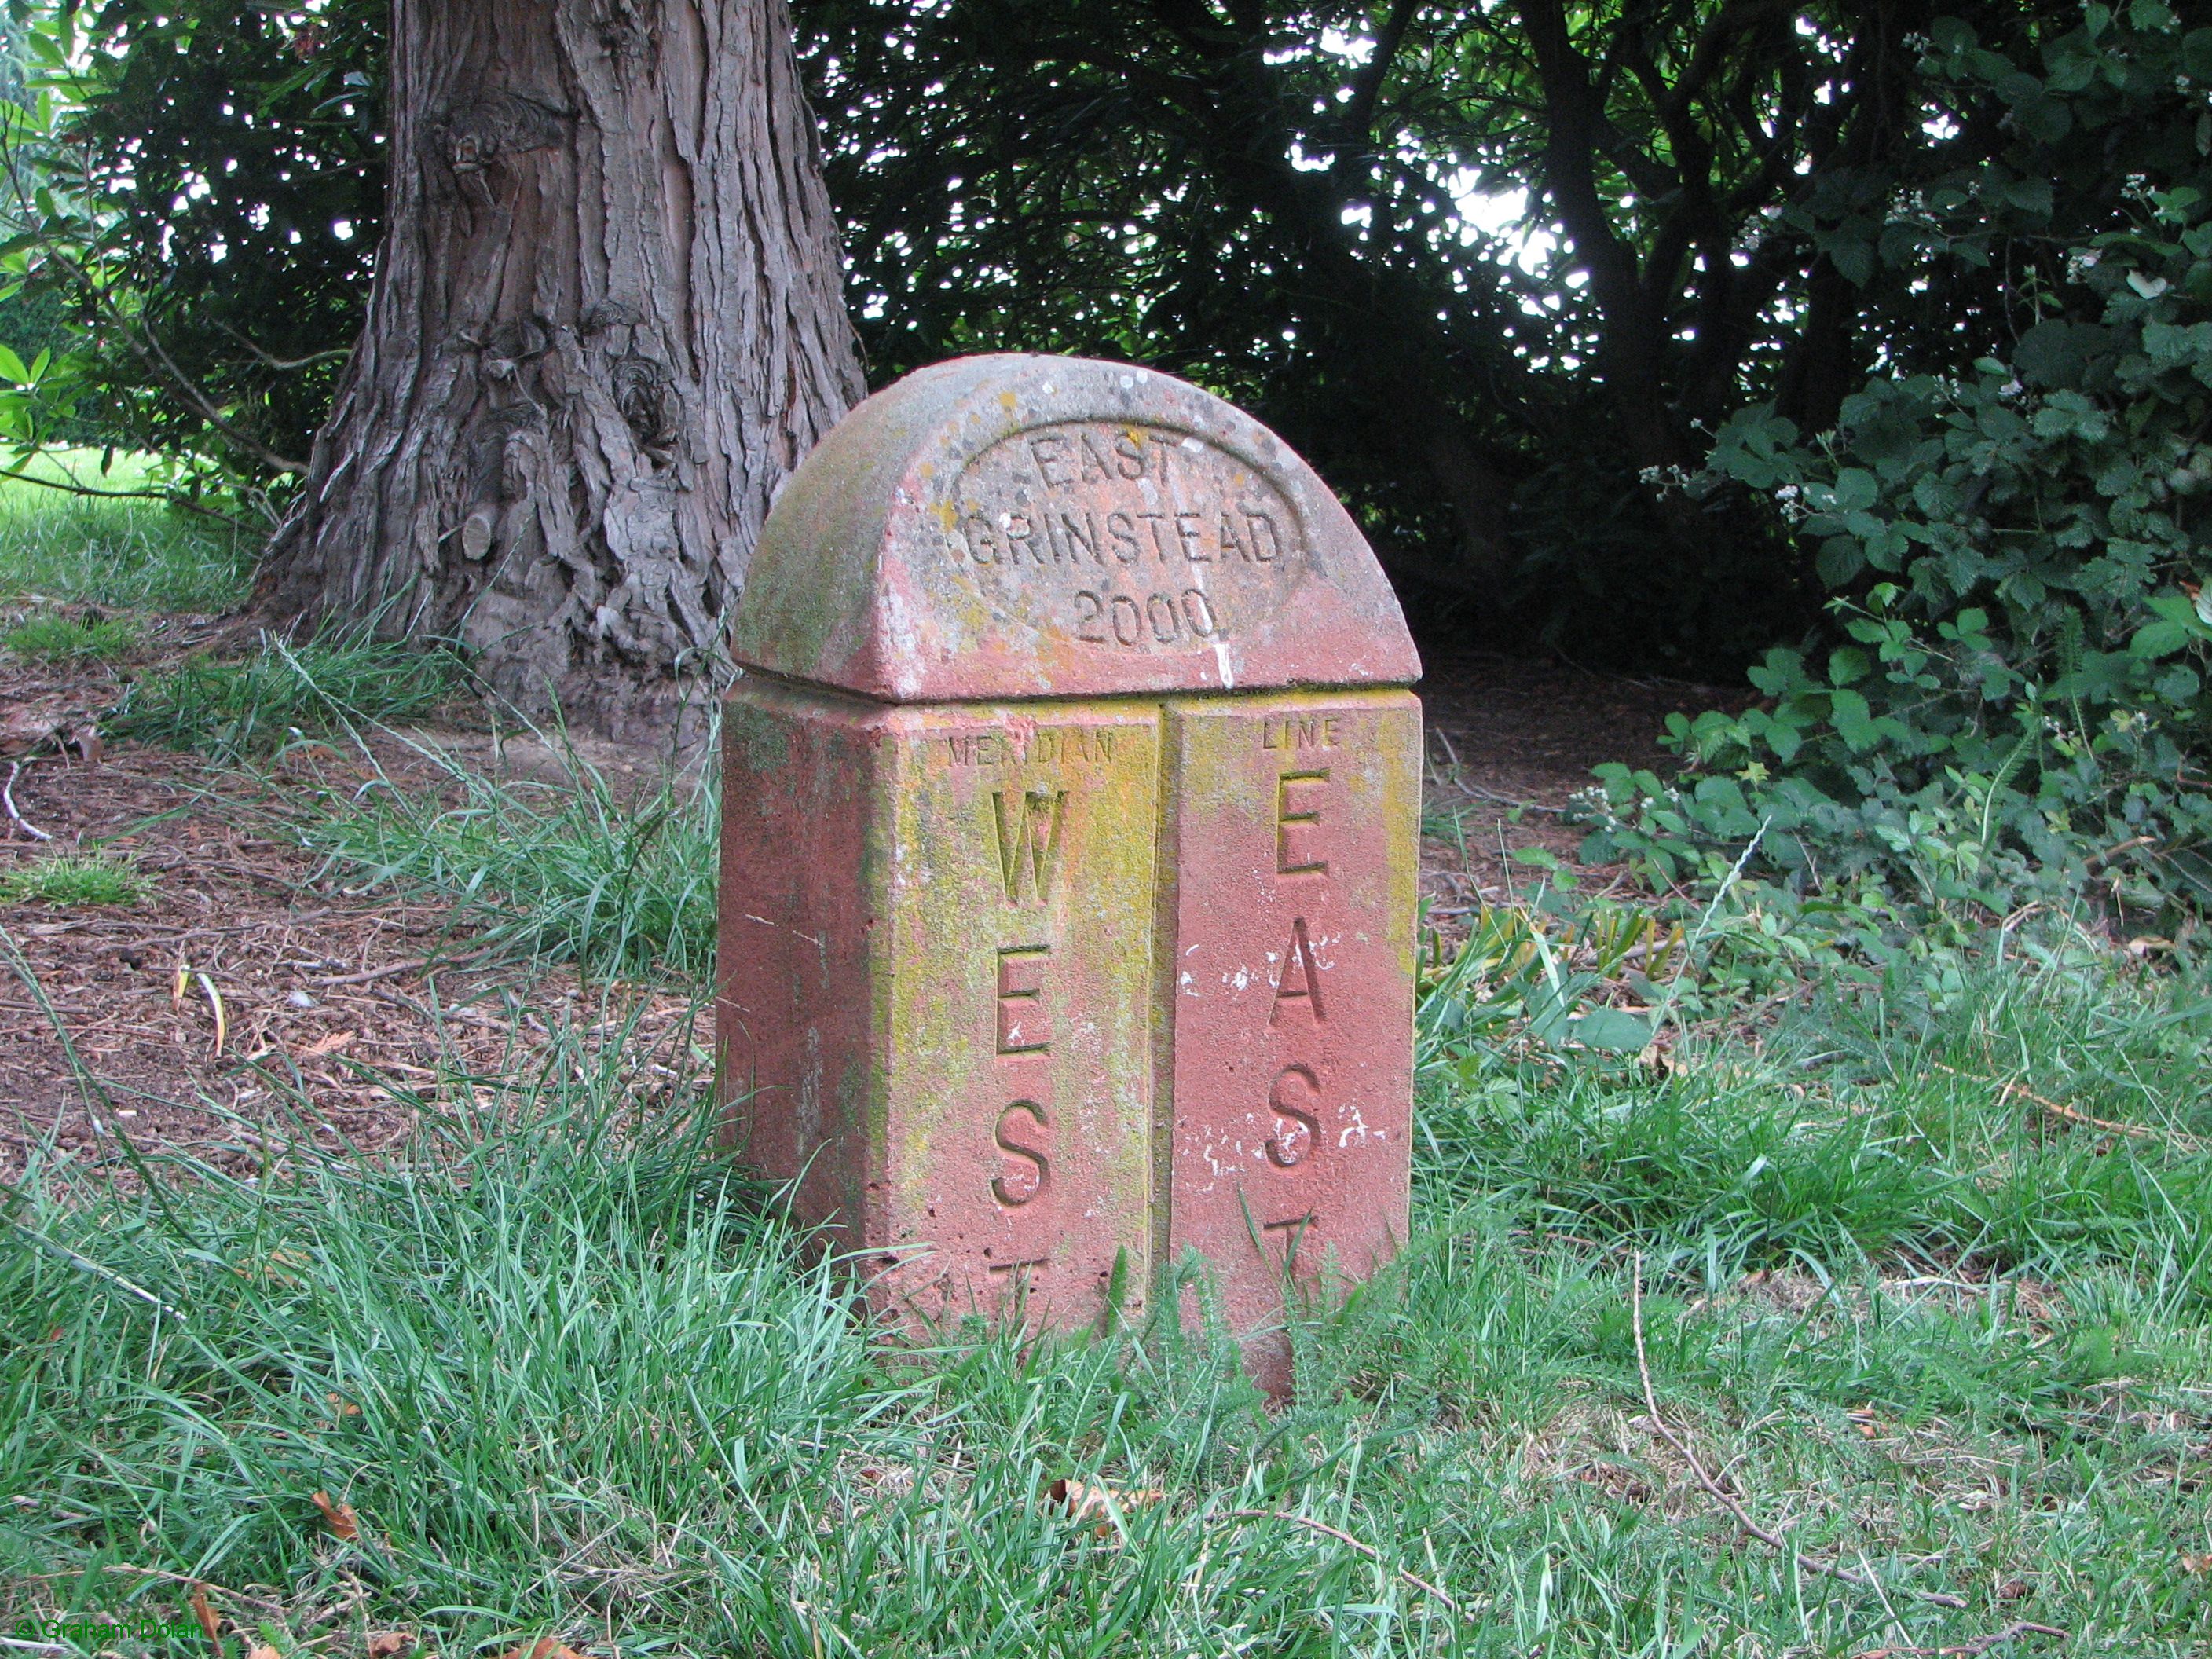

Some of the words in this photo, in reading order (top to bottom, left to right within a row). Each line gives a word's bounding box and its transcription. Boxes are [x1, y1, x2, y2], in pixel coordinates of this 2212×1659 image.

[1028, 429, 1178, 489] EAST
[960, 511, 1282, 566] GRINSTEAD
[1073, 588, 1217, 646] 2000
[945, 727, 1115, 767] MERIDIAN
[1262, 716, 1340, 751] LINE
[1262, 767, 1333, 1288] EAST
[987, 790, 1068, 1335] WEST
